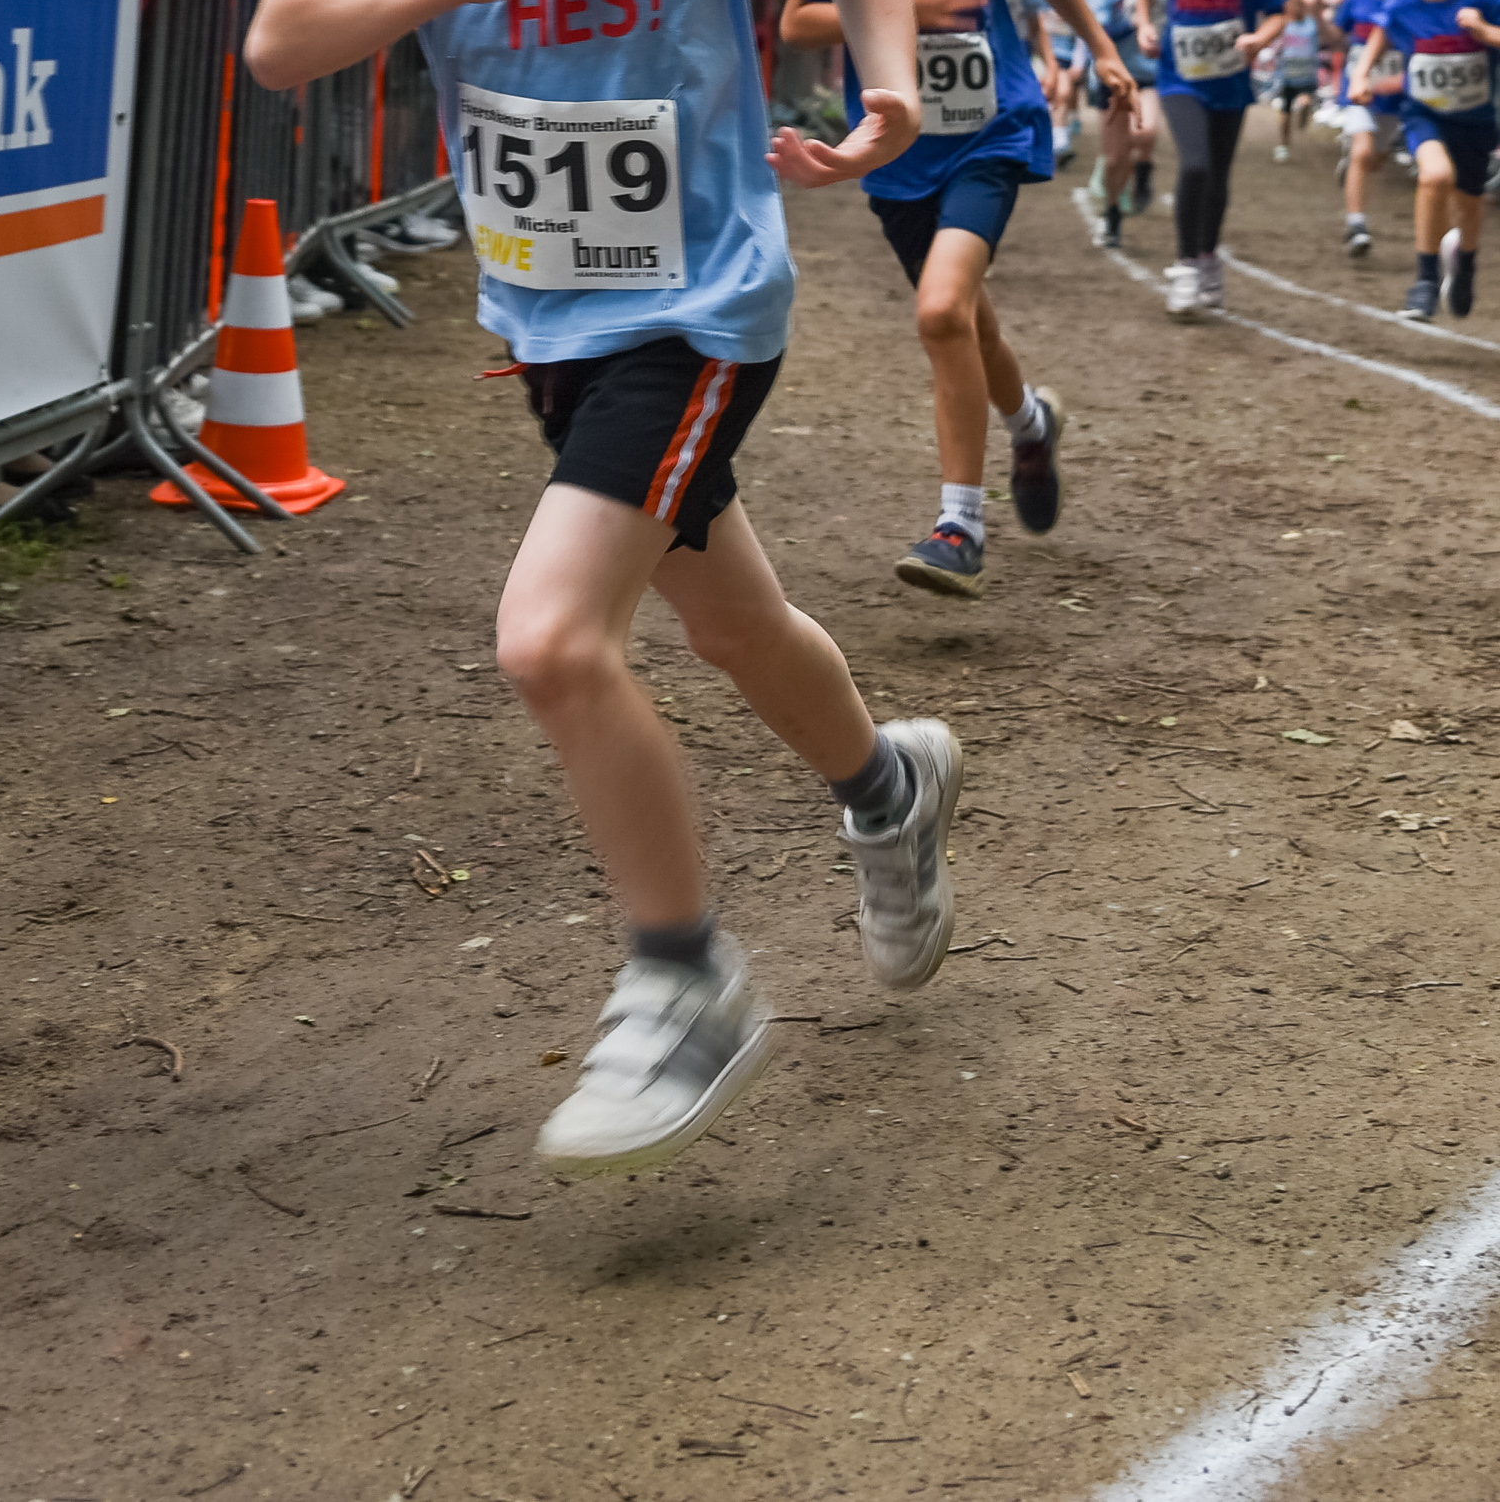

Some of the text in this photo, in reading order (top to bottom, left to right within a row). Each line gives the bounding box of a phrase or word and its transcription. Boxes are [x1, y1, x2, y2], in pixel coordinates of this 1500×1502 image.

[941, 104, 986, 122] bruns
[533, 115, 660, 132] Brunnenlauf
[463, 124, 671, 213] 1519
[514, 215, 578, 233] Michel
[572, 237, 660, 268] bruns
